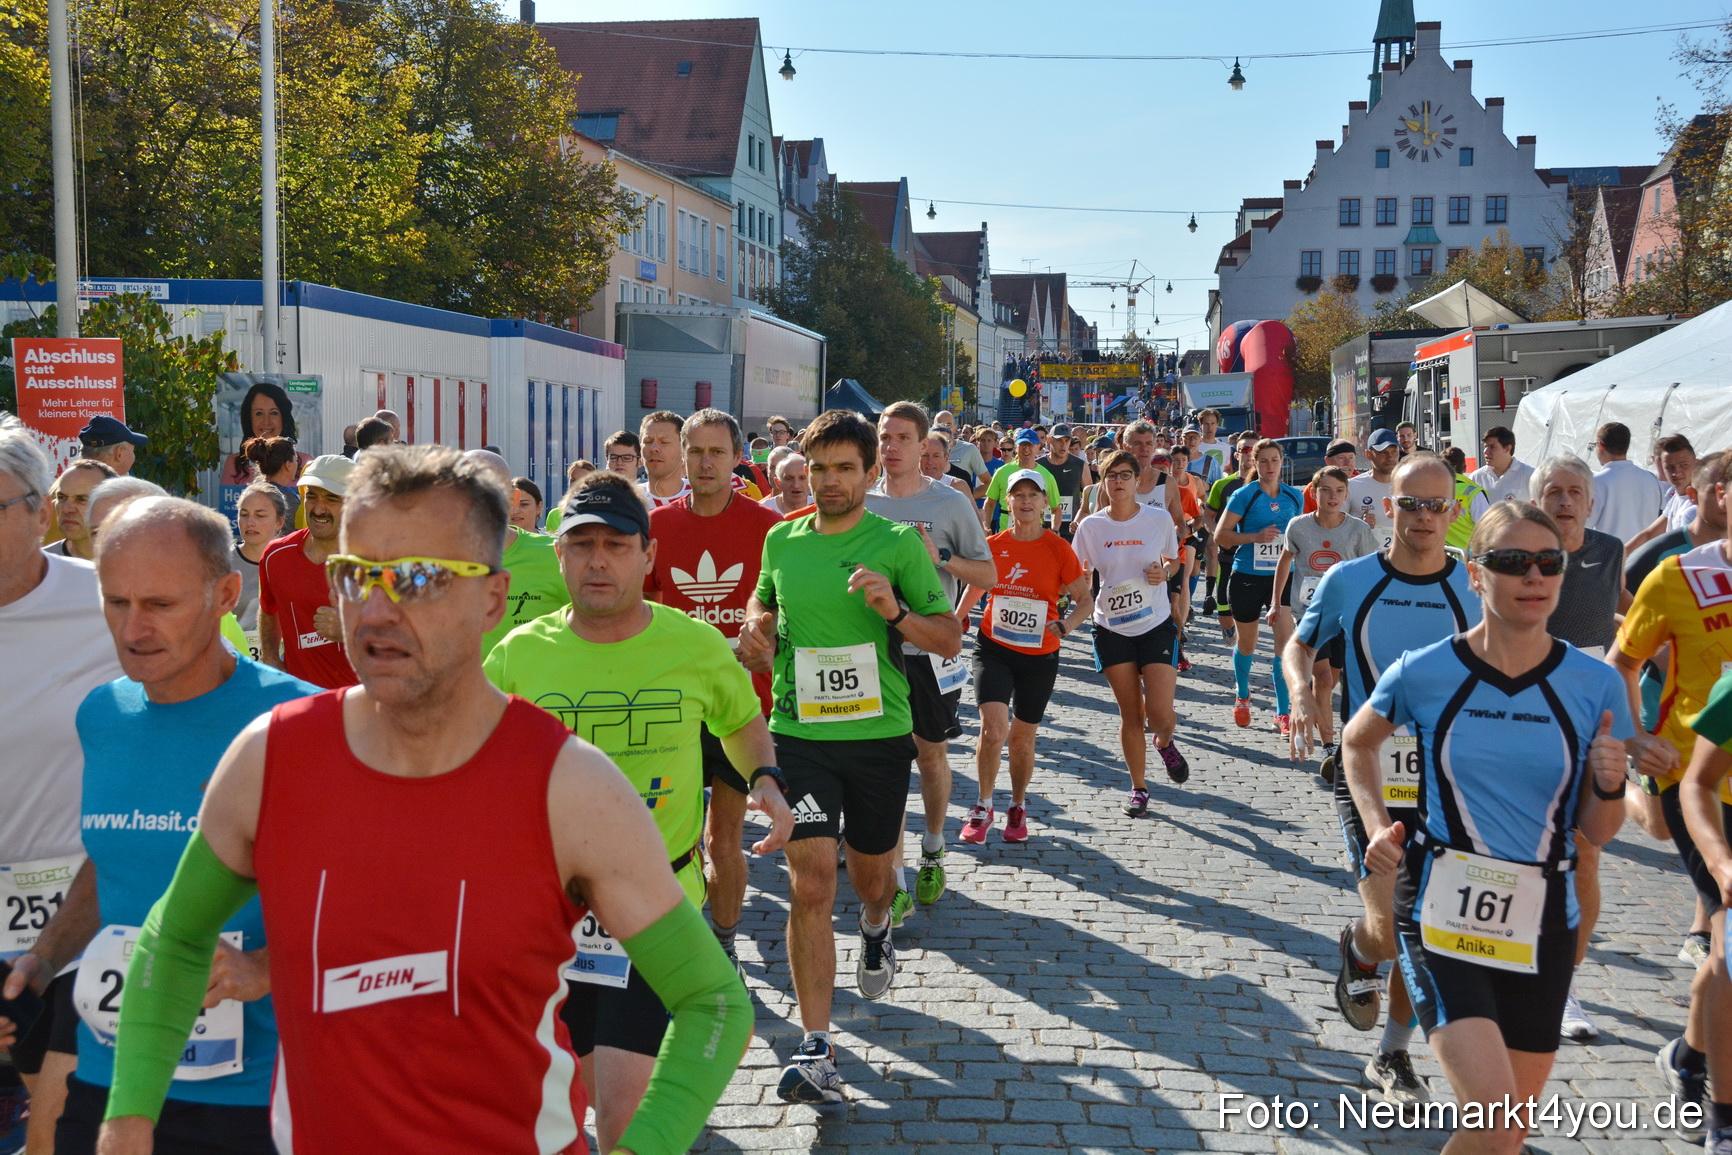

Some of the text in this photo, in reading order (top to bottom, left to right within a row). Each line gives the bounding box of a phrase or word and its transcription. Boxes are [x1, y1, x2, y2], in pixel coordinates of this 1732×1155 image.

[24, 347, 116, 364] Abschluss
[24, 365, 55, 375] statt
[1072, 367, 1107, 376] START
[25, 375, 117, 390] Ausschluss!
[42, 398, 114, 408] Mehr Lehrer für
[38, 408, 115, 419] kleinere Klassen.
[1003, 589, 1041, 598] neumarkt
[1107, 590, 1143, 611] 2275
[684, 605, 746, 625] didas
[1000, 608, 1038, 629] 3025
[818, 653, 853, 665] BOCK
[815, 668, 860, 693] 195
[832, 692, 857, 700] Neumarkt
[819, 702, 861, 715] Andreas
[658, 745, 679, 754] GmbH
[1390, 750, 1420, 775] 16
[1389, 787, 1418, 799] Chris
[14, 866, 74, 886] BOCK
[1466, 864, 1518, 886] BOCK
[1456, 885, 1514, 924] 161
[1445, 919, 1504, 936] PARTL Neumarkt
[1456, 936, 1496, 957] Anika
[357, 967, 415, 994] DEHN
